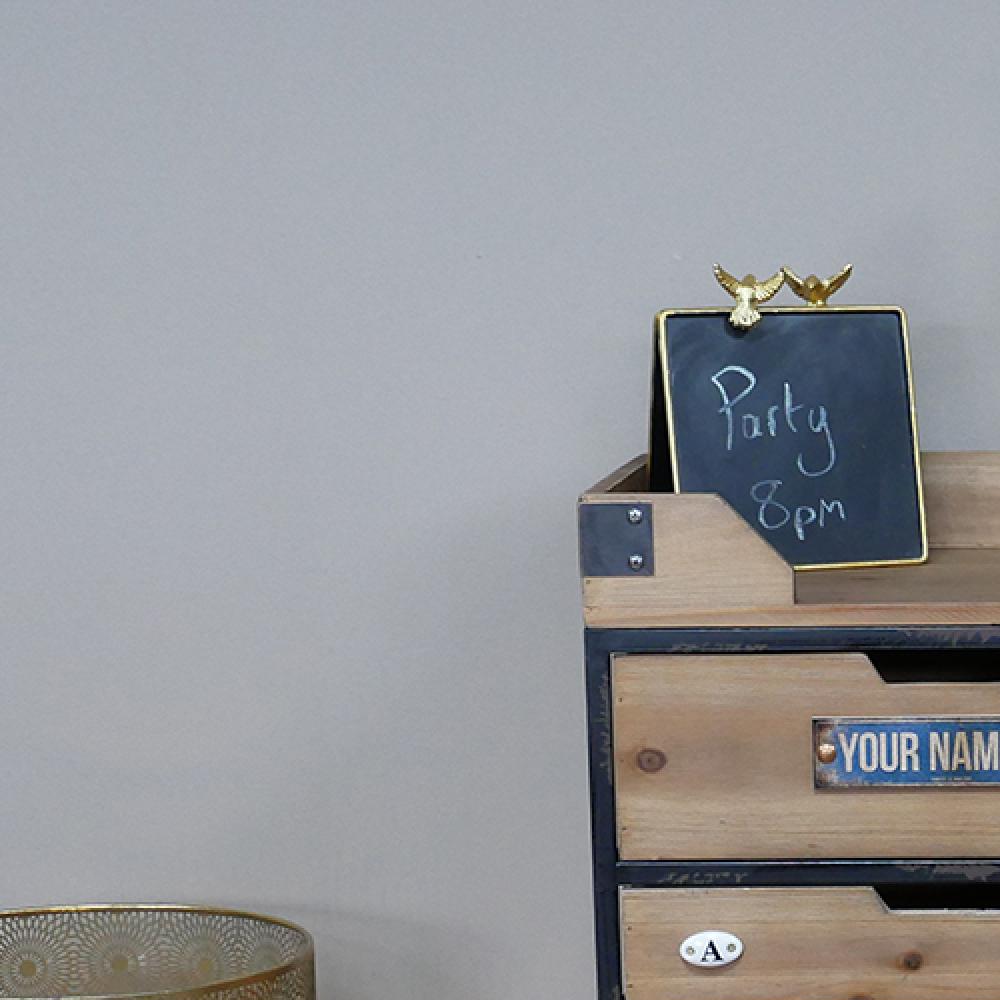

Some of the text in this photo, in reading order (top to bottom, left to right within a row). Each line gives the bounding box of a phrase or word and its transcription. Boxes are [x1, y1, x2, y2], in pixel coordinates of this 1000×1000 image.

[711, 366, 836, 477] Party
[838, 731, 919, 773] YOUR
[701, 939, 724, 962] A
